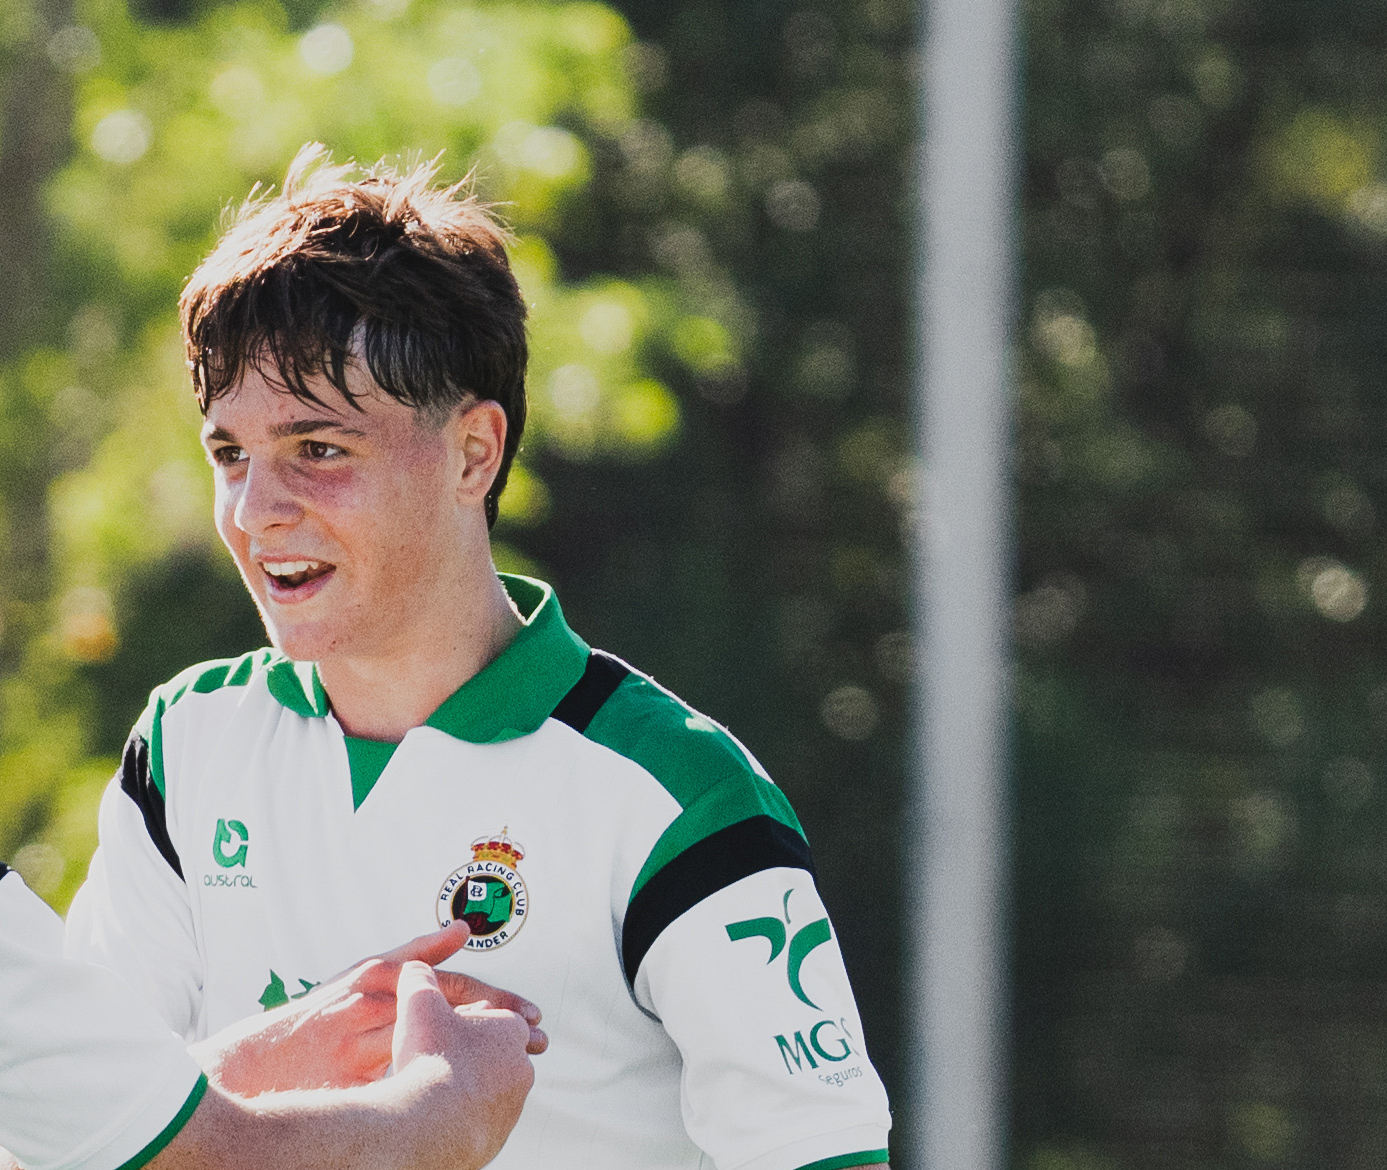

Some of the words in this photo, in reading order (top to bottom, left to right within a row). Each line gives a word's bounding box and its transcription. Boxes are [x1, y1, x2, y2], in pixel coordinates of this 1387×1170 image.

[440, 872, 464, 901] REAL
[467, 862, 515, 881] RACING
[512, 880, 525, 916] CLUB
[441, 919, 509, 949] SANDER
